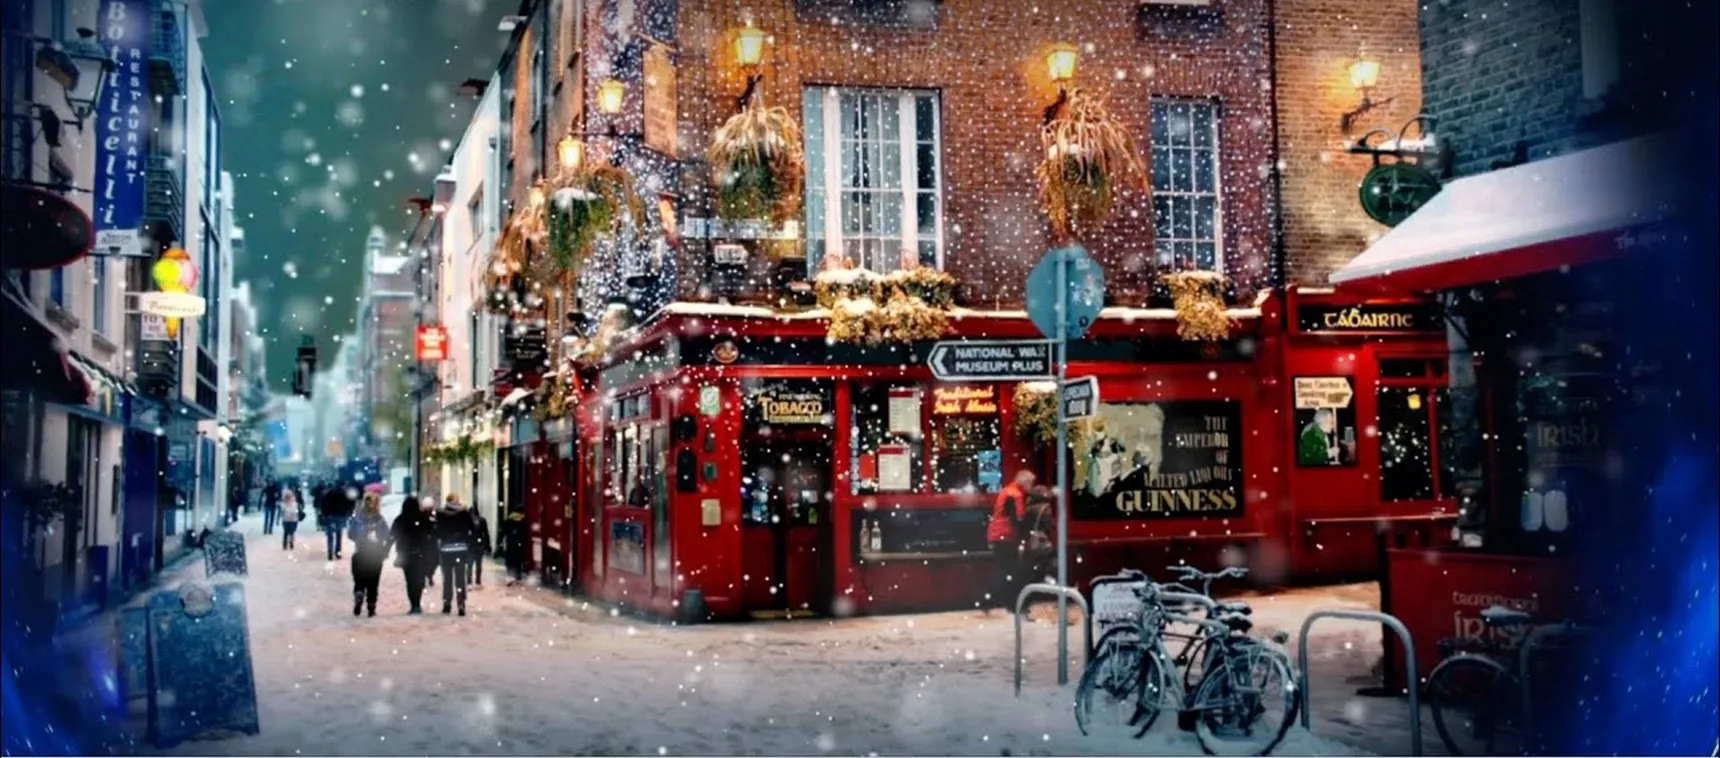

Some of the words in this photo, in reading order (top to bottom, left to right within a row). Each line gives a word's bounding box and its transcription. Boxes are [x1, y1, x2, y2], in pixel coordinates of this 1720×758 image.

[127, 48, 141, 184] RESTAURANT
[955, 347, 1015, 359] NATIONAL
[1019, 346, 1046, 358] WAX
[955, 361, 1010, 372] MUSEUM
[1012, 361, 1044, 371] PLUS
[757, 396, 823, 420] TOBACCO
[1204, 416, 1228, 431] THE
[1115, 489, 1237, 512] GUINNESS
